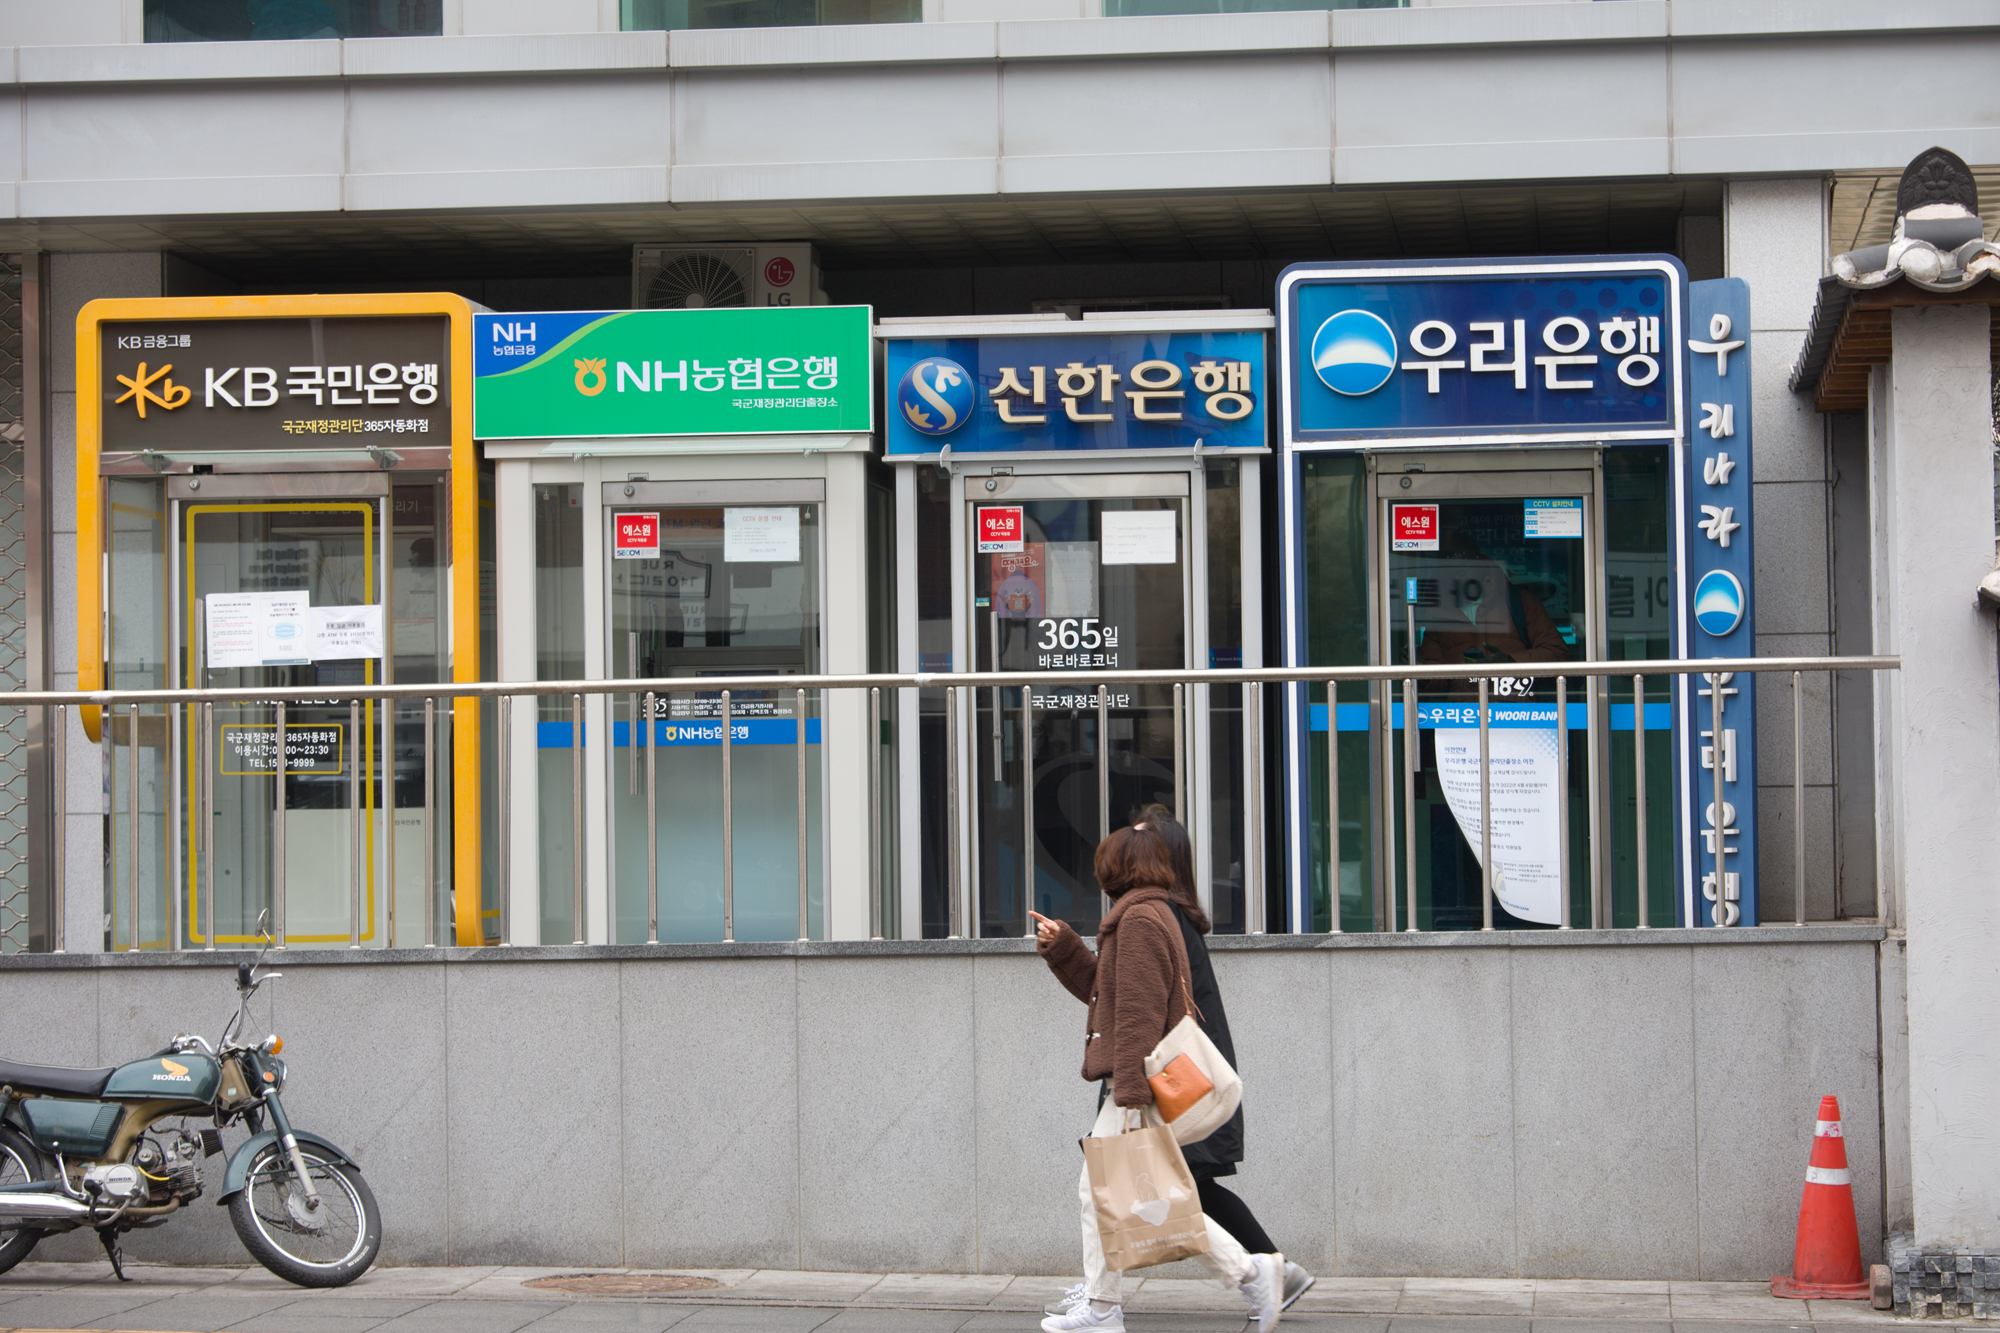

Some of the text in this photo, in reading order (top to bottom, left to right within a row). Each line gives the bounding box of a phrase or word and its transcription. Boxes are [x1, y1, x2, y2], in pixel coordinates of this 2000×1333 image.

[767, 292, 791, 306] LG
[493, 322, 536, 343] NH
[117, 334, 192, 350] KB금융그룹
[493, 344, 536, 356] 농협금융
[1401, 316, 1660, 394] 우리은행
[616, 356, 839, 393] NH농협은행
[204, 362, 439, 408] KB국민은행
[988, 360, 1254, 424] 신한은행
[732, 396, 839, 409] 국군재정관리단출장소
[1688, 313, 1746, 548] 우리나라
[986, 518, 1015, 530] 에스원
[1401, 516, 1430, 528] 에스원
[623, 524, 651, 536] 에스원
[1395, 541, 1419, 549] SECOM
[617, 549, 640, 557] SECOM
[1037, 618, 1119, 651] 365일
[1038, 653, 1118, 669] 바로바로코너
[1495, 711, 1530, 721] WOORI
[226, 732, 337, 743] 국군재정관리365자동화점
[152, 1073, 192, 1082] HONDA
